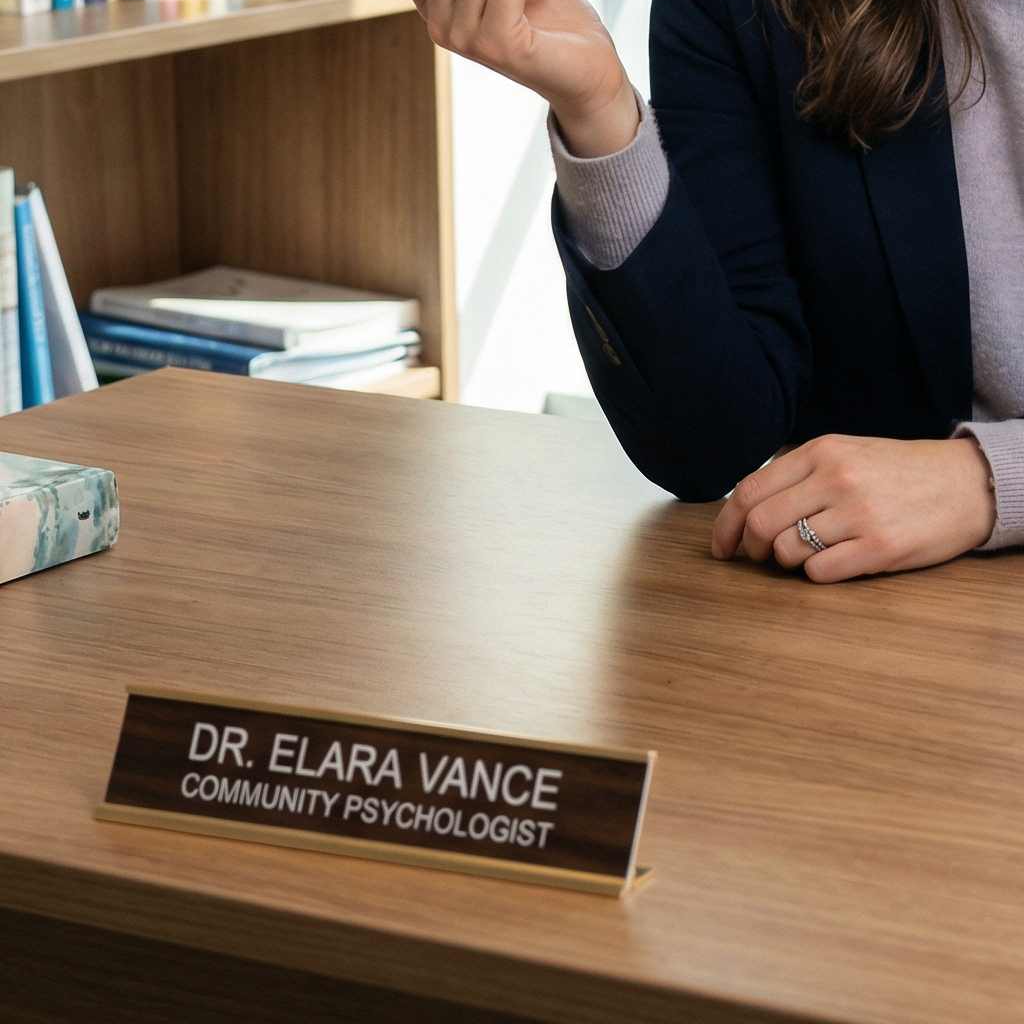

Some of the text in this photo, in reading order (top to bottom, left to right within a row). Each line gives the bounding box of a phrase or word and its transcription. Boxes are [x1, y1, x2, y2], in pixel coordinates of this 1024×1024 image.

[188, 722, 563, 810] DR. ELARA VANCE
[181, 772, 554, 847] COMMUNITY PSYCHOLOGIST
